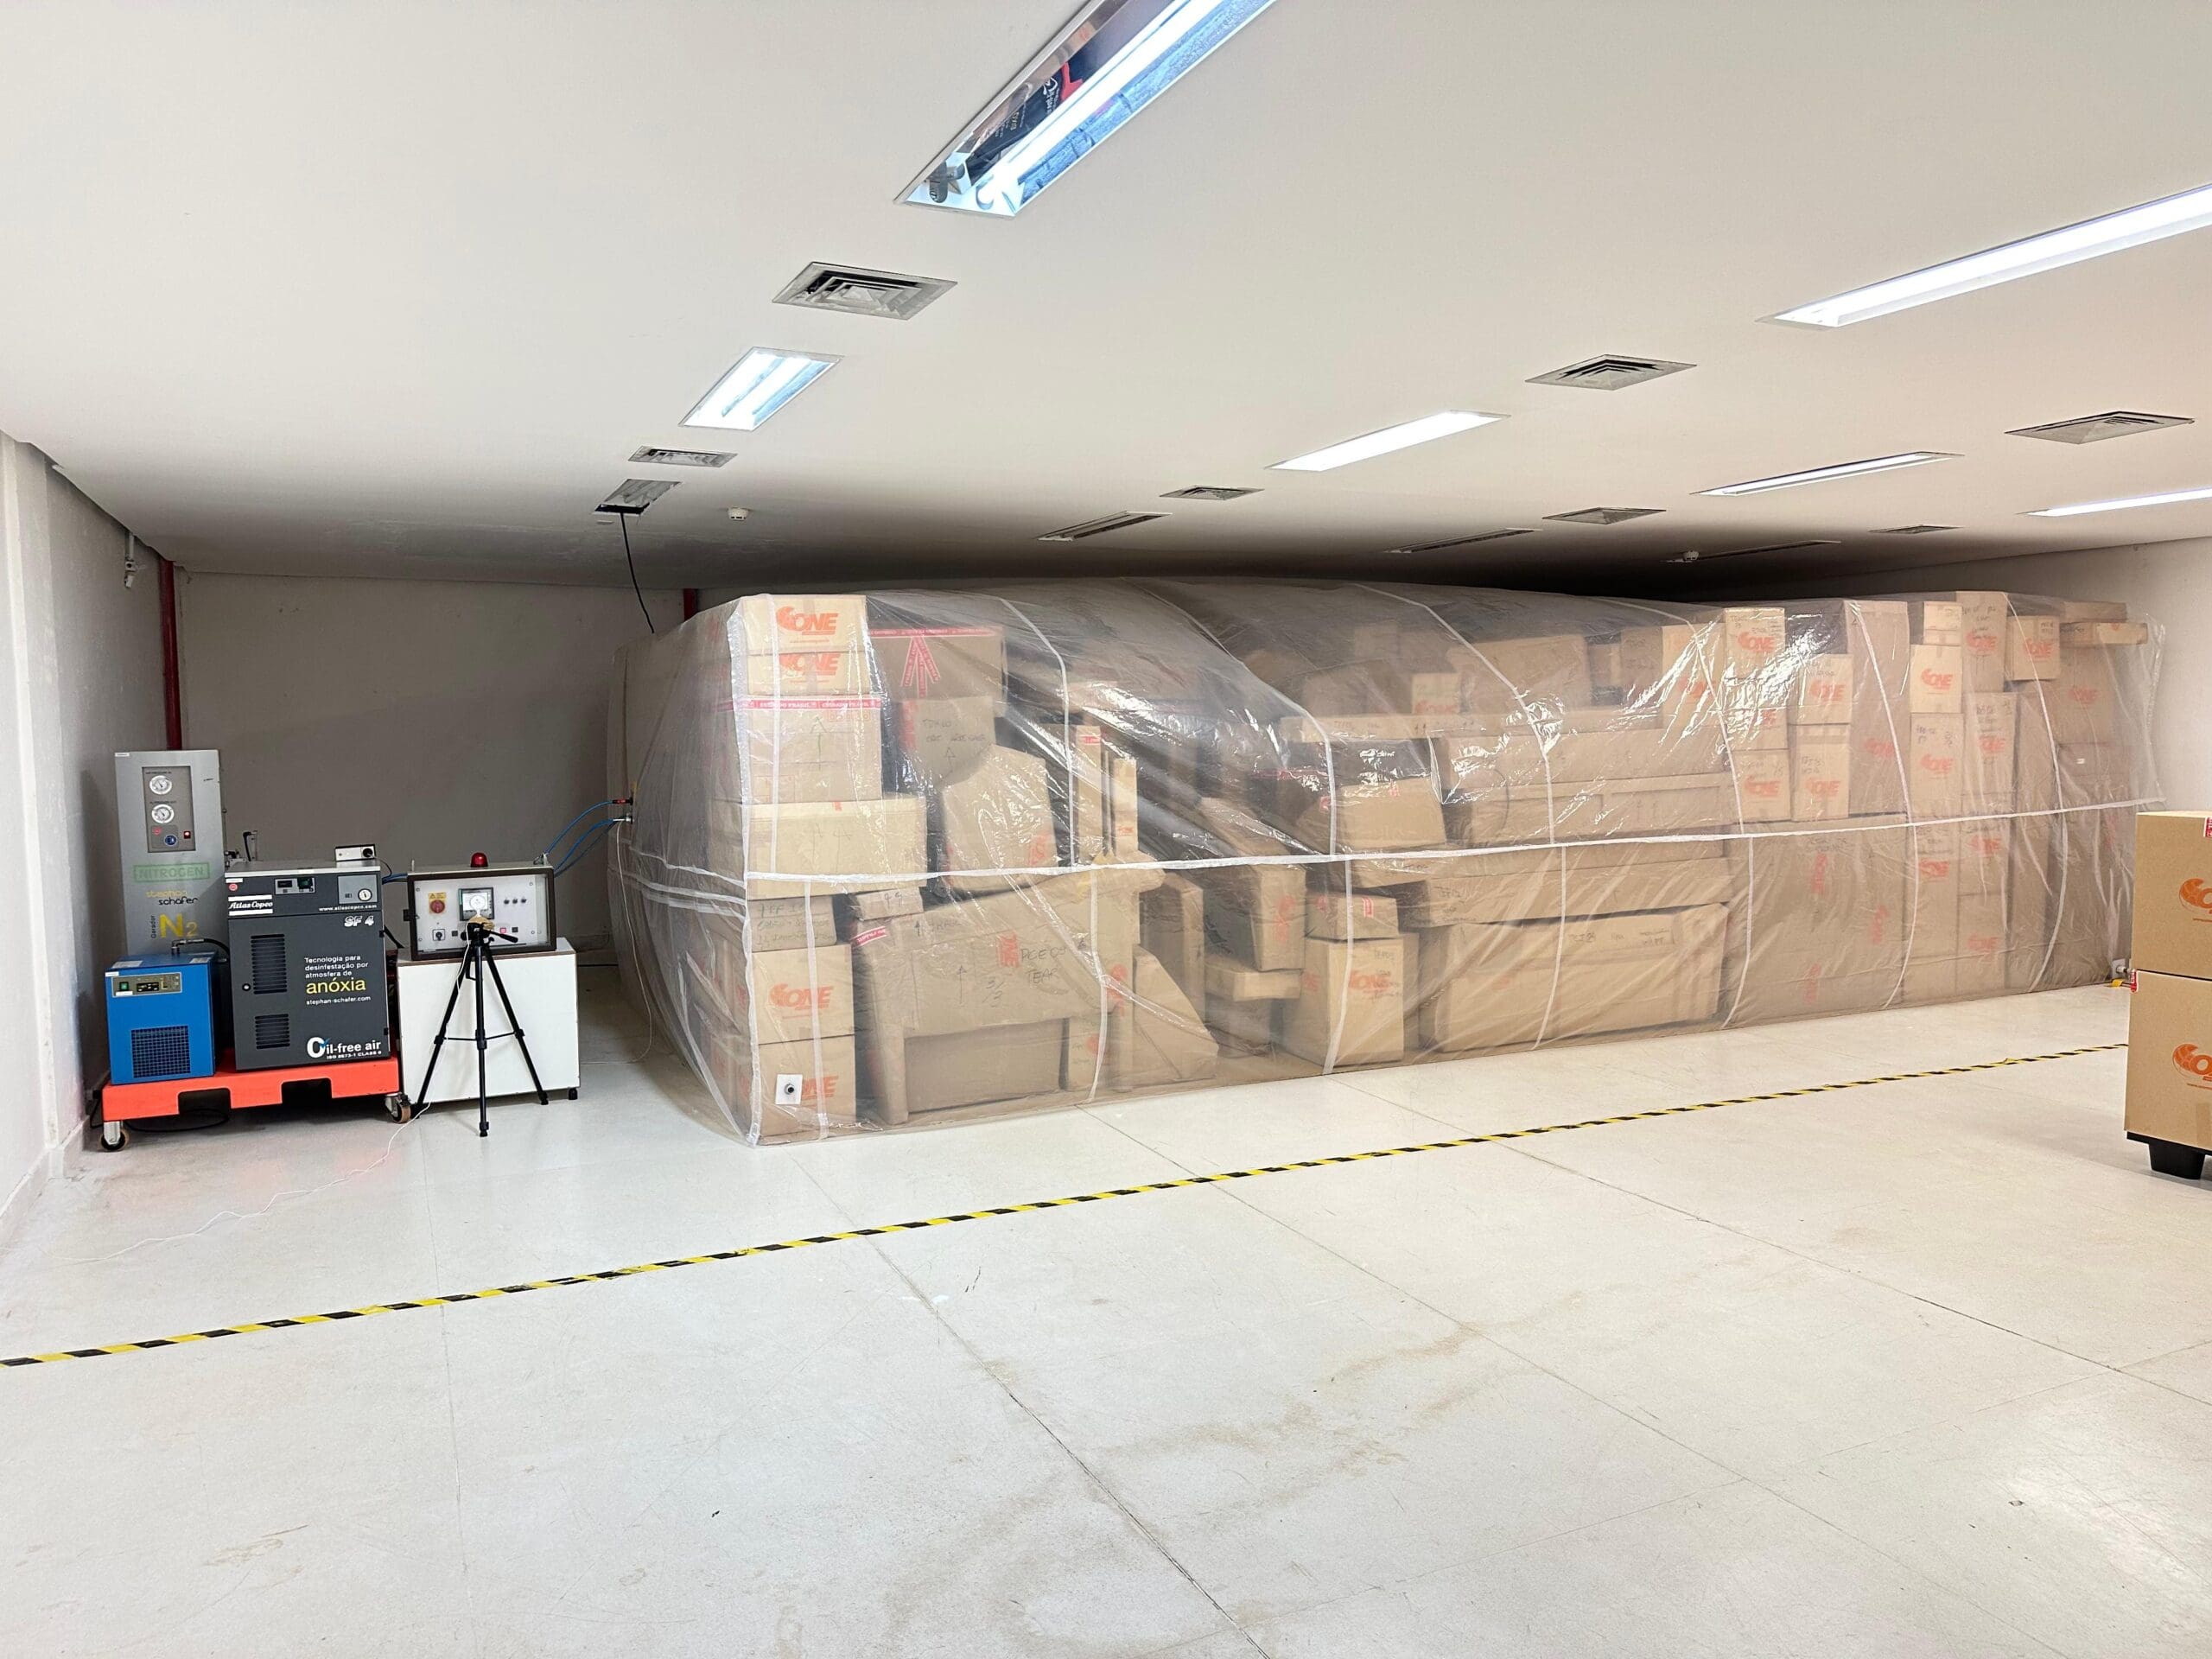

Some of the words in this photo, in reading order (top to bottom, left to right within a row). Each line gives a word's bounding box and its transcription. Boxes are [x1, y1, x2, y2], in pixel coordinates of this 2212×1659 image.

[138, 867, 204, 879] NITROGEN
[251, 900, 273, 909] Copco
[344, 916, 363, 927] SF
[365, 915, 375, 926] 4
[305, 963, 354, 971] desinfestação
[306, 977, 366, 994] anóxia
[306, 995, 372, 1005] stephan-schafer.com
[307, 1037, 362, 1058] Oil-free
[365, 1039, 382, 1051] air
